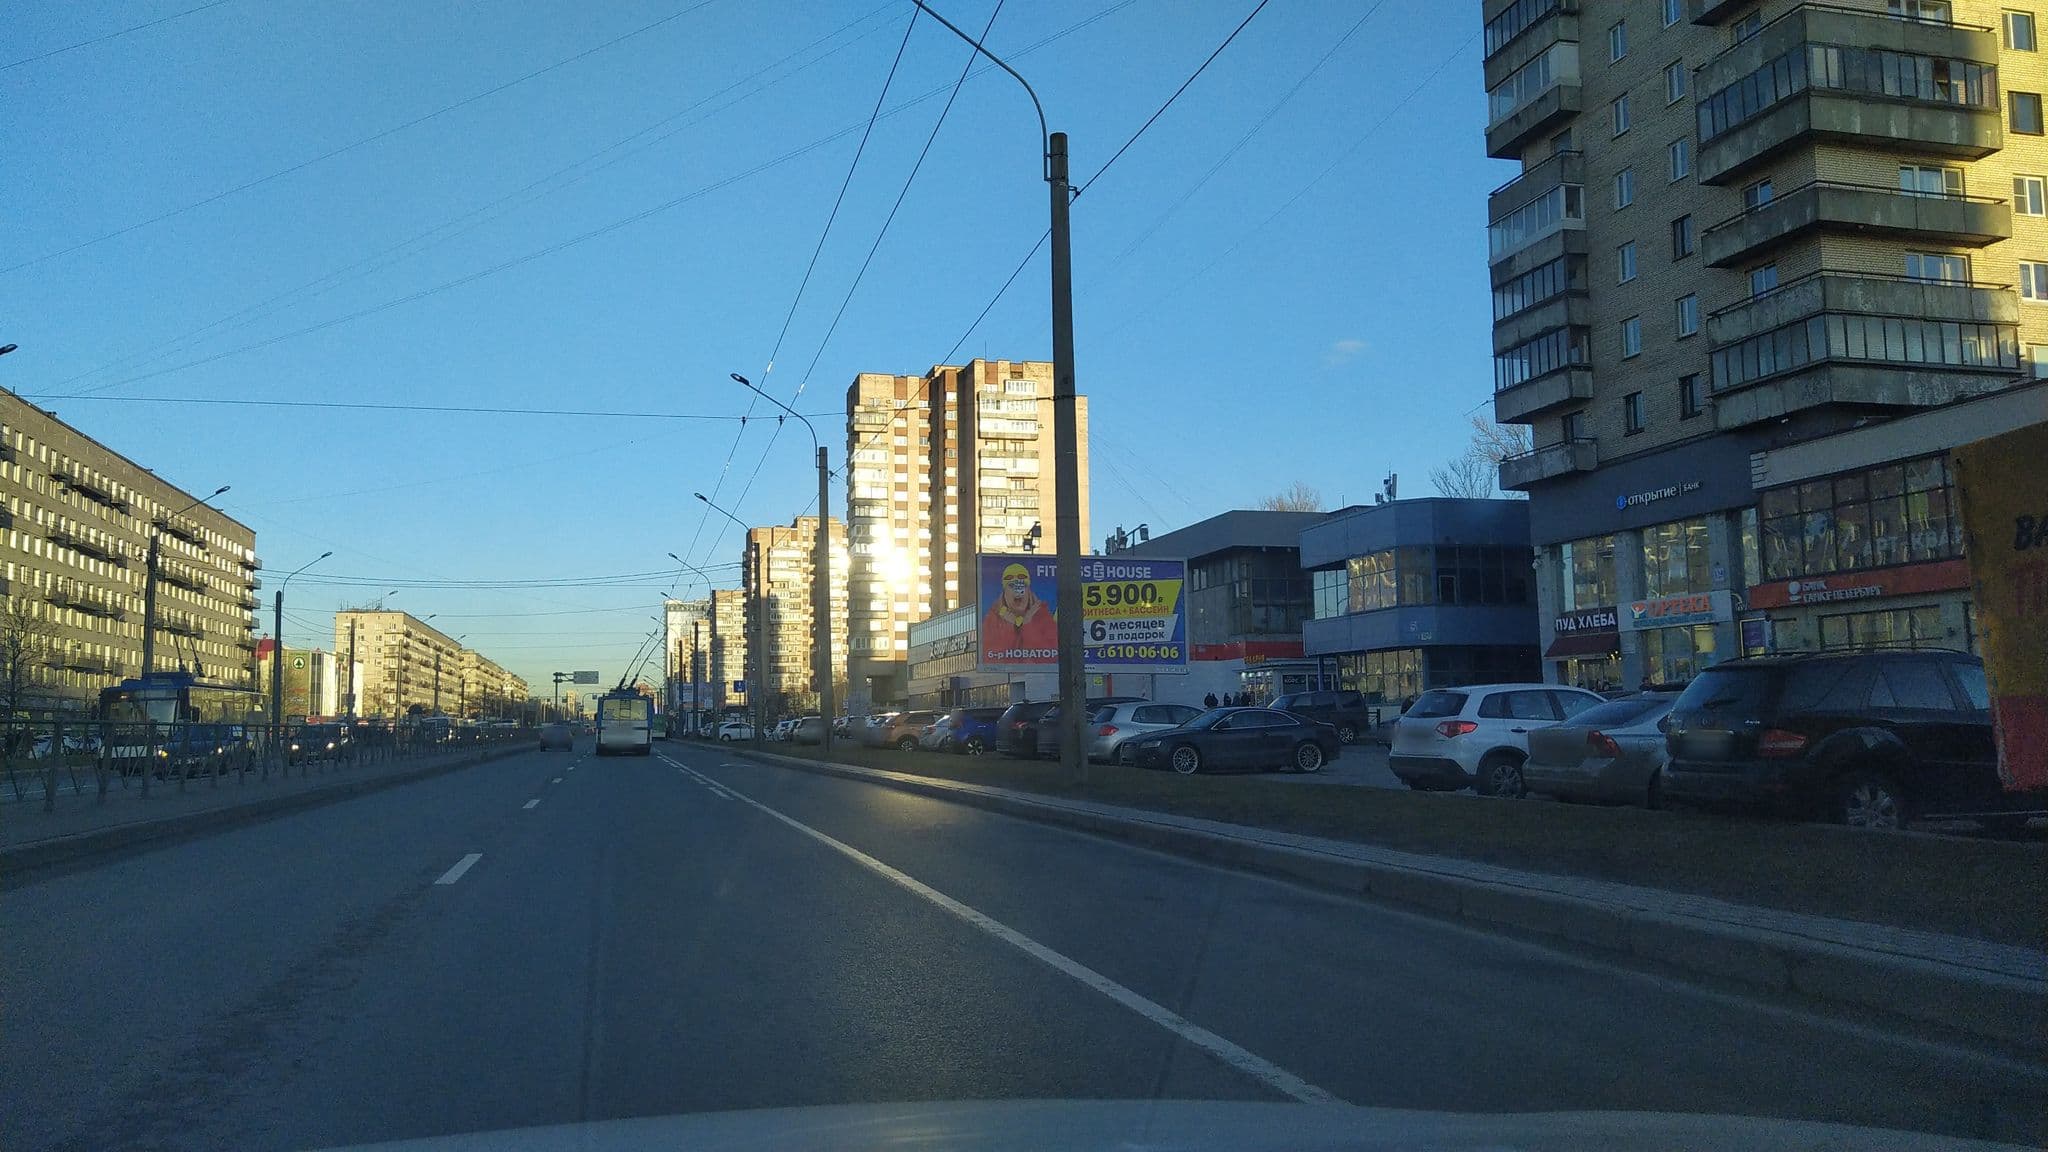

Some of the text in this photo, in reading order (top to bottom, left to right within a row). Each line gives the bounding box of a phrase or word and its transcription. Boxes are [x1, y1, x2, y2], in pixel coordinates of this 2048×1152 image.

[1628, 481, 1700, 505] открытие БАНК
[1107, 566, 1151, 579] HOUSE
[1801, 580, 1826, 591] БАНК
[1109, 619, 1165, 631] месяцев
[1555, 618, 1576, 632] ПУД
[1578, 613, 1616, 628] ХЛЕБА
[1109, 631, 1165, 641] в подарок
[1005, 649, 1058, 658] НОВАТОР
